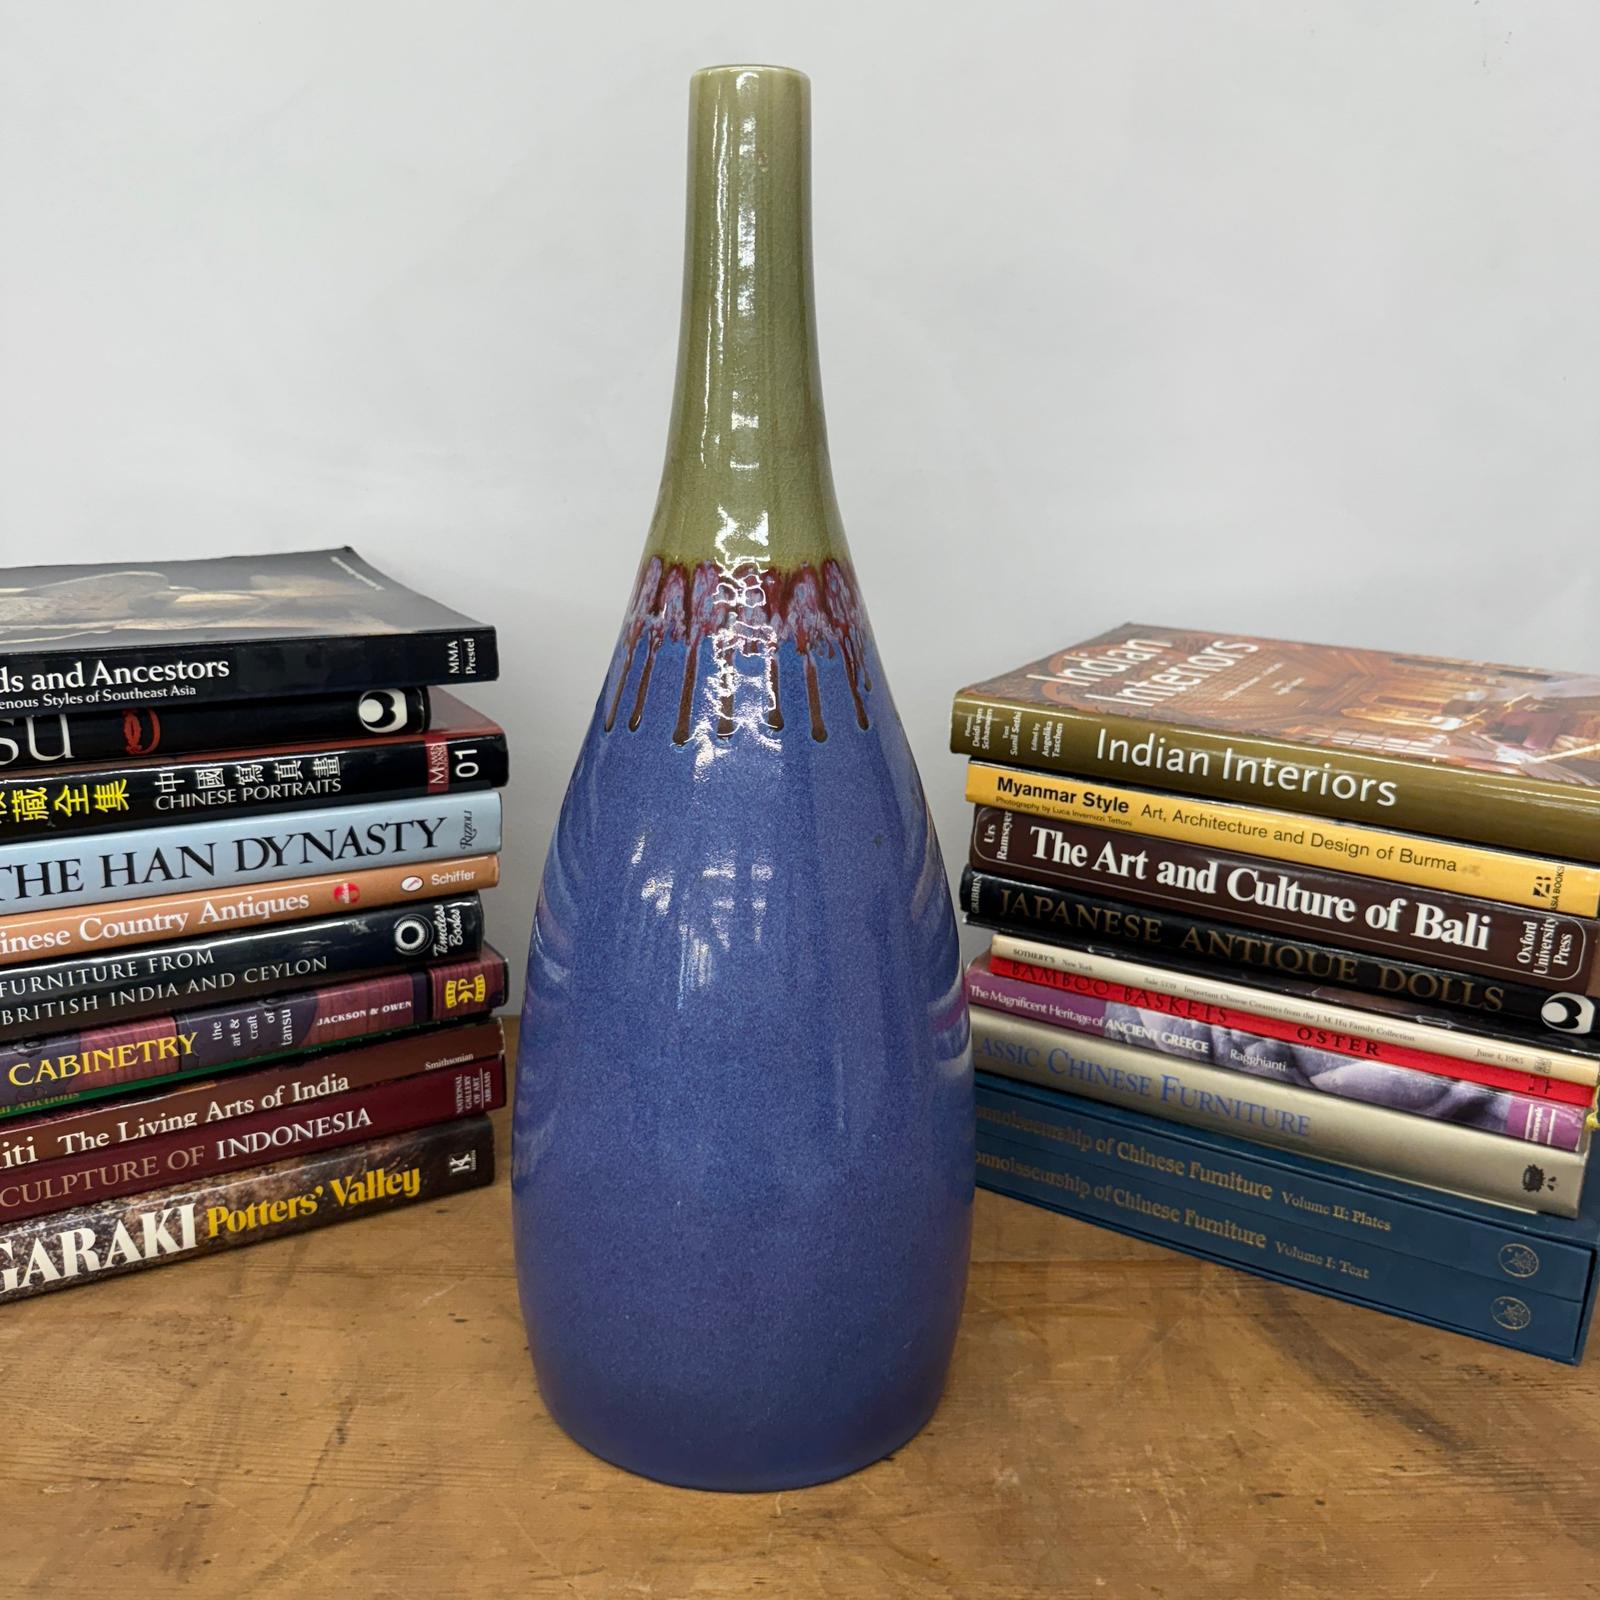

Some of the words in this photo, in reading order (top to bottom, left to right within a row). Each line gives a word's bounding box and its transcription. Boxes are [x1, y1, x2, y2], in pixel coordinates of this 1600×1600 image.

[31, 661, 86, 690] and
[91, 659, 230, 687] Ancestors
[448, 640, 461, 674] MMA
[464, 638, 476, 675] Prestel
[1027, 637, 1174, 687] Indian
[1085, 639, 1259, 707] Interiors
[43, 692, 83, 708] Styles
[86, 691, 101, 703] of
[103, 684, 168, 702] Southeast
[170, 684, 197, 697] Asia
[1012, 710, 1022, 733] Sethi
[1042, 721, 1053, 757] Angelika
[1010, 734, 1019, 756] Sunil
[1052, 723, 1063, 758] Taschen
[454, 749, 478, 778] 01
[1096, 728, 1210, 777] Indian
[1222, 748, 1398, 808] Interiors
[156, 787, 237, 810] CHINESE
[243, 778, 341, 801] PORTRAITS
[984, 824, 996, 843] Urs
[996, 811, 1013, 860] Ramseyer
[997, 777, 1077, 804] Myanmar
[1082, 791, 1129, 814] Style
[1141, 804, 1167, 822] Art,
[1172, 809, 1268, 838] Architecture
[1273, 826, 1304, 845] and
[1311, 833, 1370, 858] Design
[1376, 846, 1394, 861] of
[1400, 848, 1457, 872] Burma
[99, 842, 217, 889] HAN
[232, 817, 448, 872] DYNASTY
[431, 869, 475, 886] Schiffer
[1029, 826, 1088, 868] The
[1092, 841, 1149, 881] Art
[1157, 862, 1220, 895] and
[1227, 866, 1356, 922] Culture
[1365, 898, 1407, 932] of
[1411, 902, 1491, 951] Bali
[1553, 866, 1565, 894] BOOKS
[79, 911, 189, 942] Country
[198, 894, 309, 926] Antiques
[448, 909, 463, 946] Books
[1000, 889, 1163, 943] JAPANESE
[1180, 926, 1358, 981] ANTIQUE
[1378, 963, 1505, 1012] DOLLS
[1517, 921, 1538, 964] Oxford
[1533, 916, 1559, 975] University
[1553, 933, 1572, 966] Press
[0, 960, 138, 998] FURNITURE
[149, 949, 214, 974] FROM
[2, 993, 100, 1025] BRITISH
[111, 983, 179, 1007] INDIA
[186, 972, 236, 994] AND
[243, 956, 328, 984] CEYLON
[1012, 961, 1110, 996] BAMBOO
[1123, 985, 1229, 1024] BASKETS
[212, 1021, 223, 1040] the
[230, 1019, 240, 1029] &
[247, 1014, 259, 1039] craft
[264, 1012, 275, 1024] of
[281, 1008, 292, 1046] tansu
[317, 1007, 367, 1026] JACKSON
[369, 1006, 379, 1015] &
[382, 1001, 412, 1013] OWEN
[970, 985, 989, 999] The
[990, 991, 1048, 1014] Magnificent
[1049, 1003, 1092, 1026] Heritage
[1092, 1015, 1104, 1027] of
[1105, 1018, 1159, 1041] ANCIENT
[1161, 1031, 1210, 1054] GREECE
[231, 1032, 241, 1046] art
[1297, 1027, 1380, 1056] OSTER
[8, 1031, 198, 1087] CABINETRY
[425, 1052, 474, 1071] Smithsonian
[1230, 1049, 1287, 1073] Ragghianti
[1047, 1047, 1152, 1096] CHINESE
[1159, 1073, 1312, 1137] FURNITURE
[57, 1129, 110, 1154] The
[118, 1111, 198, 1143] Living
[205, 1097, 255, 1123] Arts
[262, 1086, 286, 1108] of
[292, 1073, 350, 1102] India
[0, 1156, 160, 1208] CULPTURE
[167, 1145, 205, 1170] OF
[216, 1107, 373, 1161] INDONESIA
[330, 1167, 421, 1208] Valley
[1096, 1138, 1113, 1156] of
[1117, 1141, 1185, 1176] Chinese
[1189, 1161, 1273, 1200] Furniture
[1281, 1191, 1330, 1216] Volume
[1352, 1210, 1392, 1232] Plates
[1094, 1184, 1113, 1201] of
[1113, 1188, 1181, 1222] Chinese
[1184, 1208, 1267, 1248] Furniture
[1275, 1240, 1323, 1266] Volume
[1339, 1260, 1371, 1279] Text
